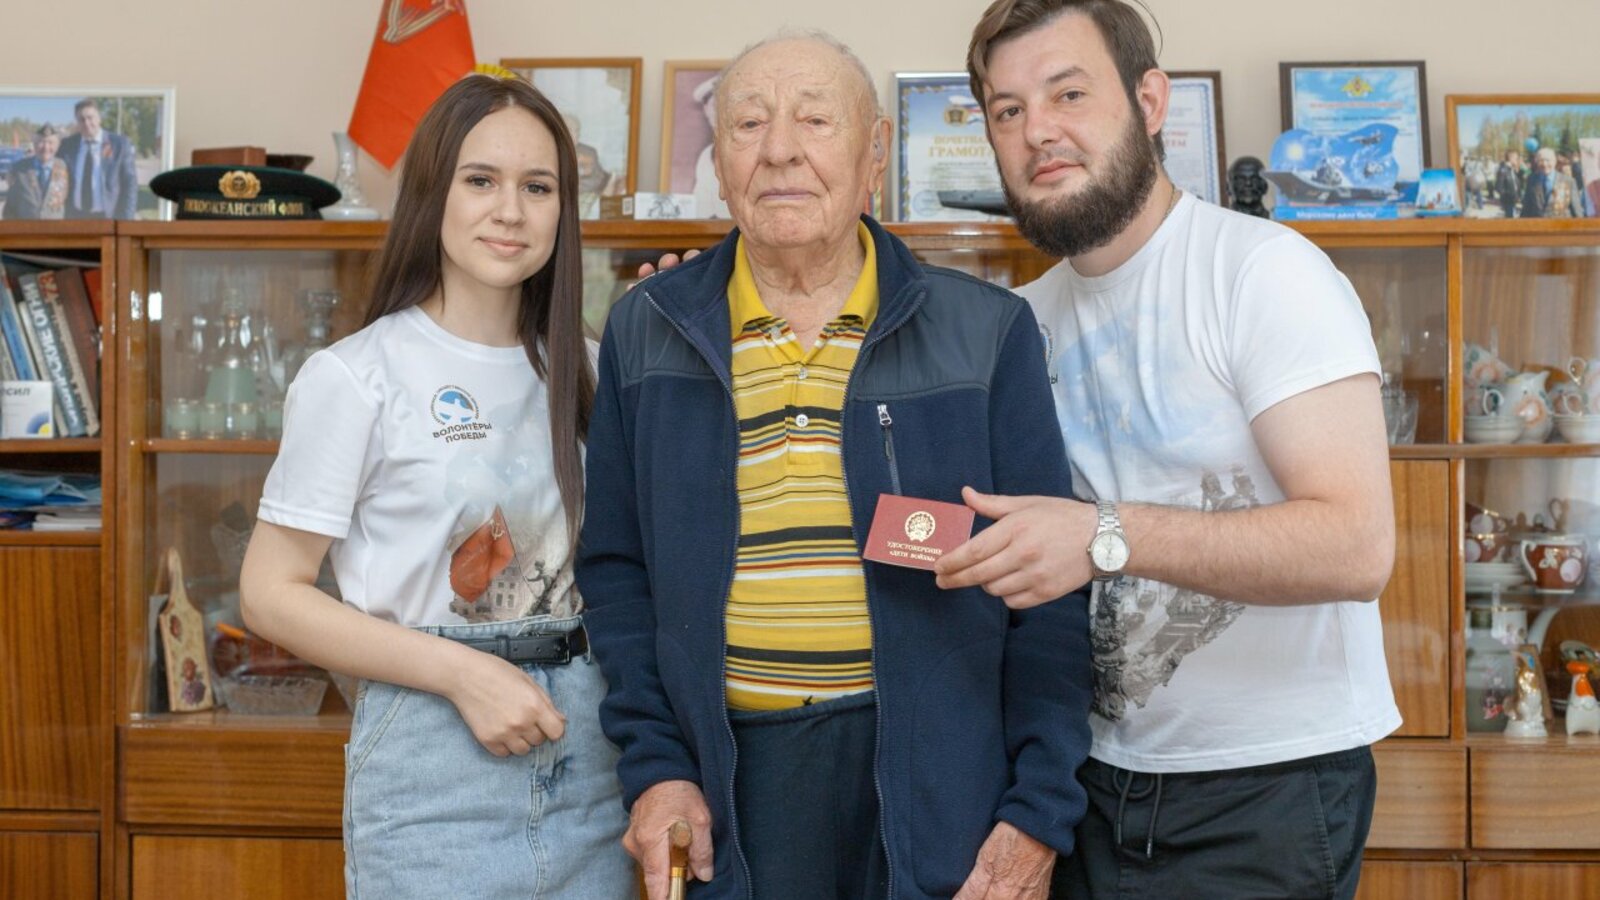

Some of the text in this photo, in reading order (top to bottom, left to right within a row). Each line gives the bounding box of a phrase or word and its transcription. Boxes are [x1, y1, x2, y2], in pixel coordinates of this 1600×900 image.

[432, 421, 493, 439] ВОЛОНТЁРЫ
[445, 431, 487, 443] ПОБЕДЫ
[887, 541, 943, 556] УДОСТОВЕРЕНИЕ
